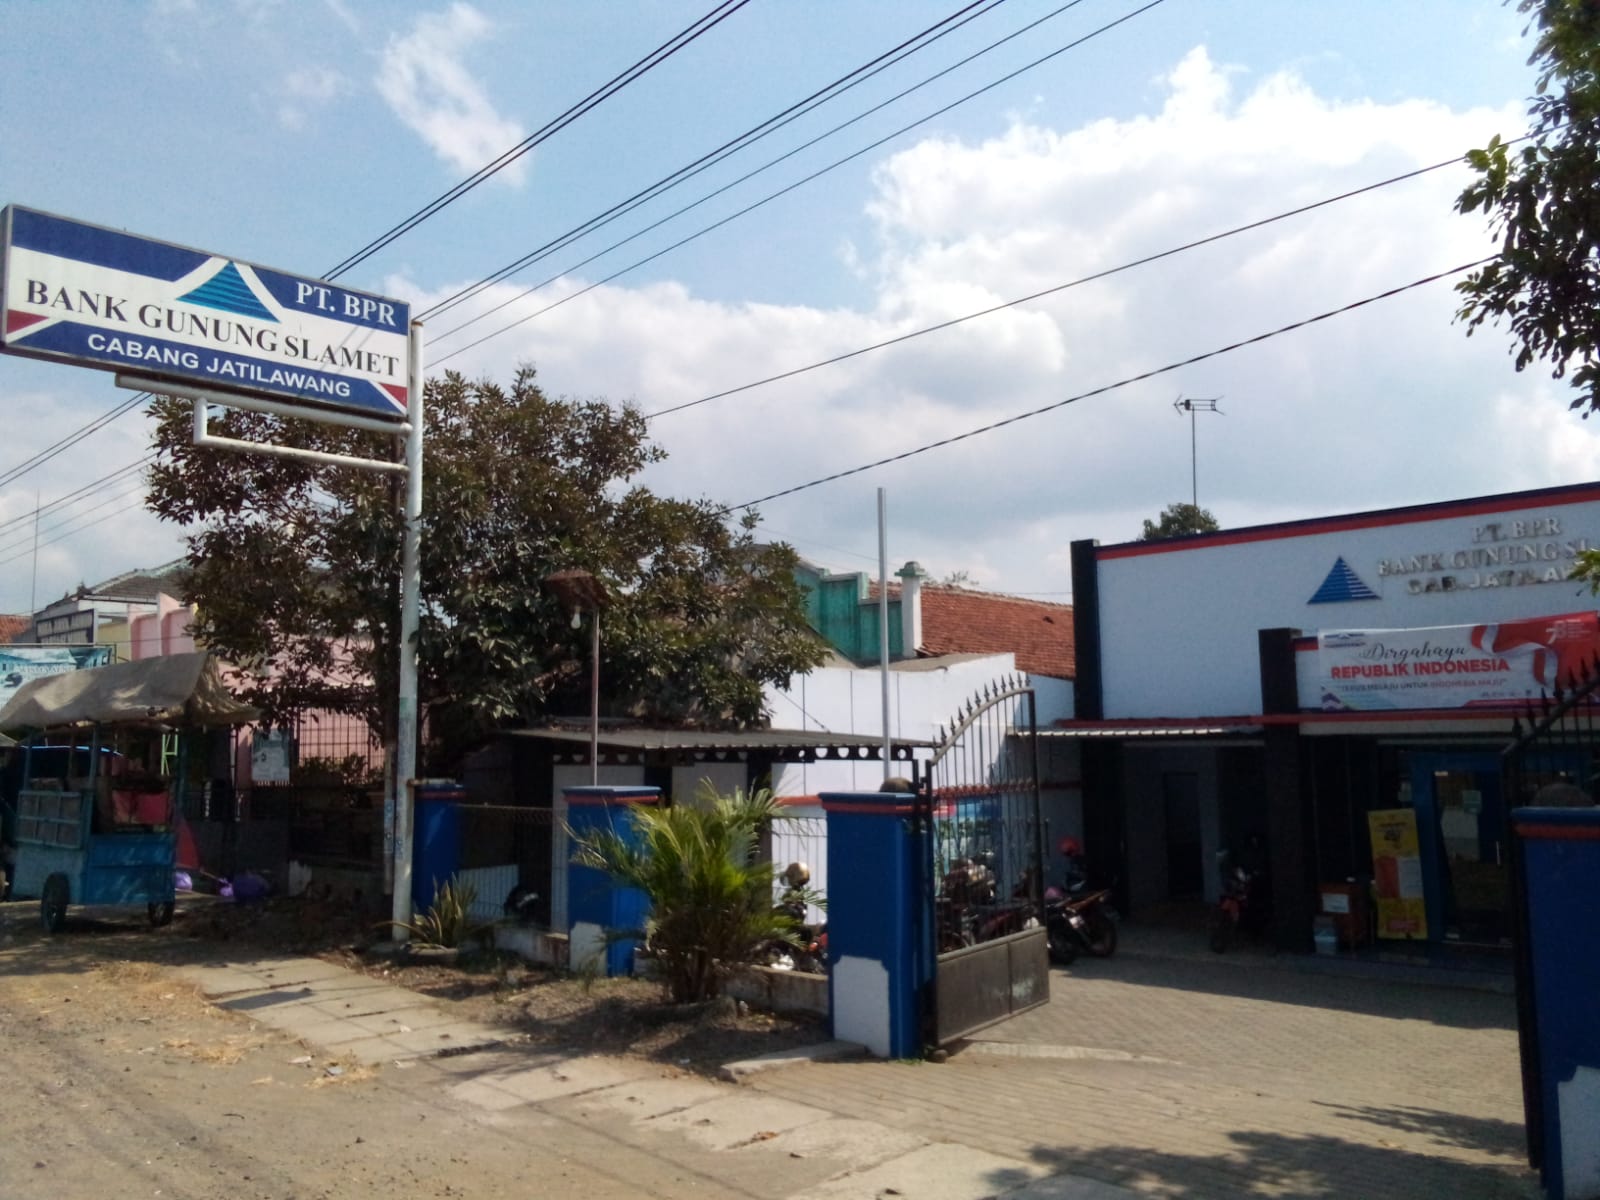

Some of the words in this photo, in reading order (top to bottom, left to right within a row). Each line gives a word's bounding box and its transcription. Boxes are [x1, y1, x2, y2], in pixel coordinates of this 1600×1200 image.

[295, 281, 336, 312] PT.
[344, 292, 396, 327] BPR
[26, 278, 129, 323] BANK
[138, 303, 278, 353] GUNUNG
[284, 334, 400, 377] SLAMET
[87, 333, 199, 369] CABANG
[206, 356, 351, 397] JATILAWANG
[1511, 517, 1562, 539] BPR
[1378, 553, 1444, 576] BANK
[1450, 541, 1559, 570] GUNUNG
[1359, 640, 1466, 664] Dirgahayu
[1330, 662, 1409, 680] REPUBLIK
[1413, 658, 1510, 678] INDONESIA
[1400, 681, 1428, 690] UNTUK
